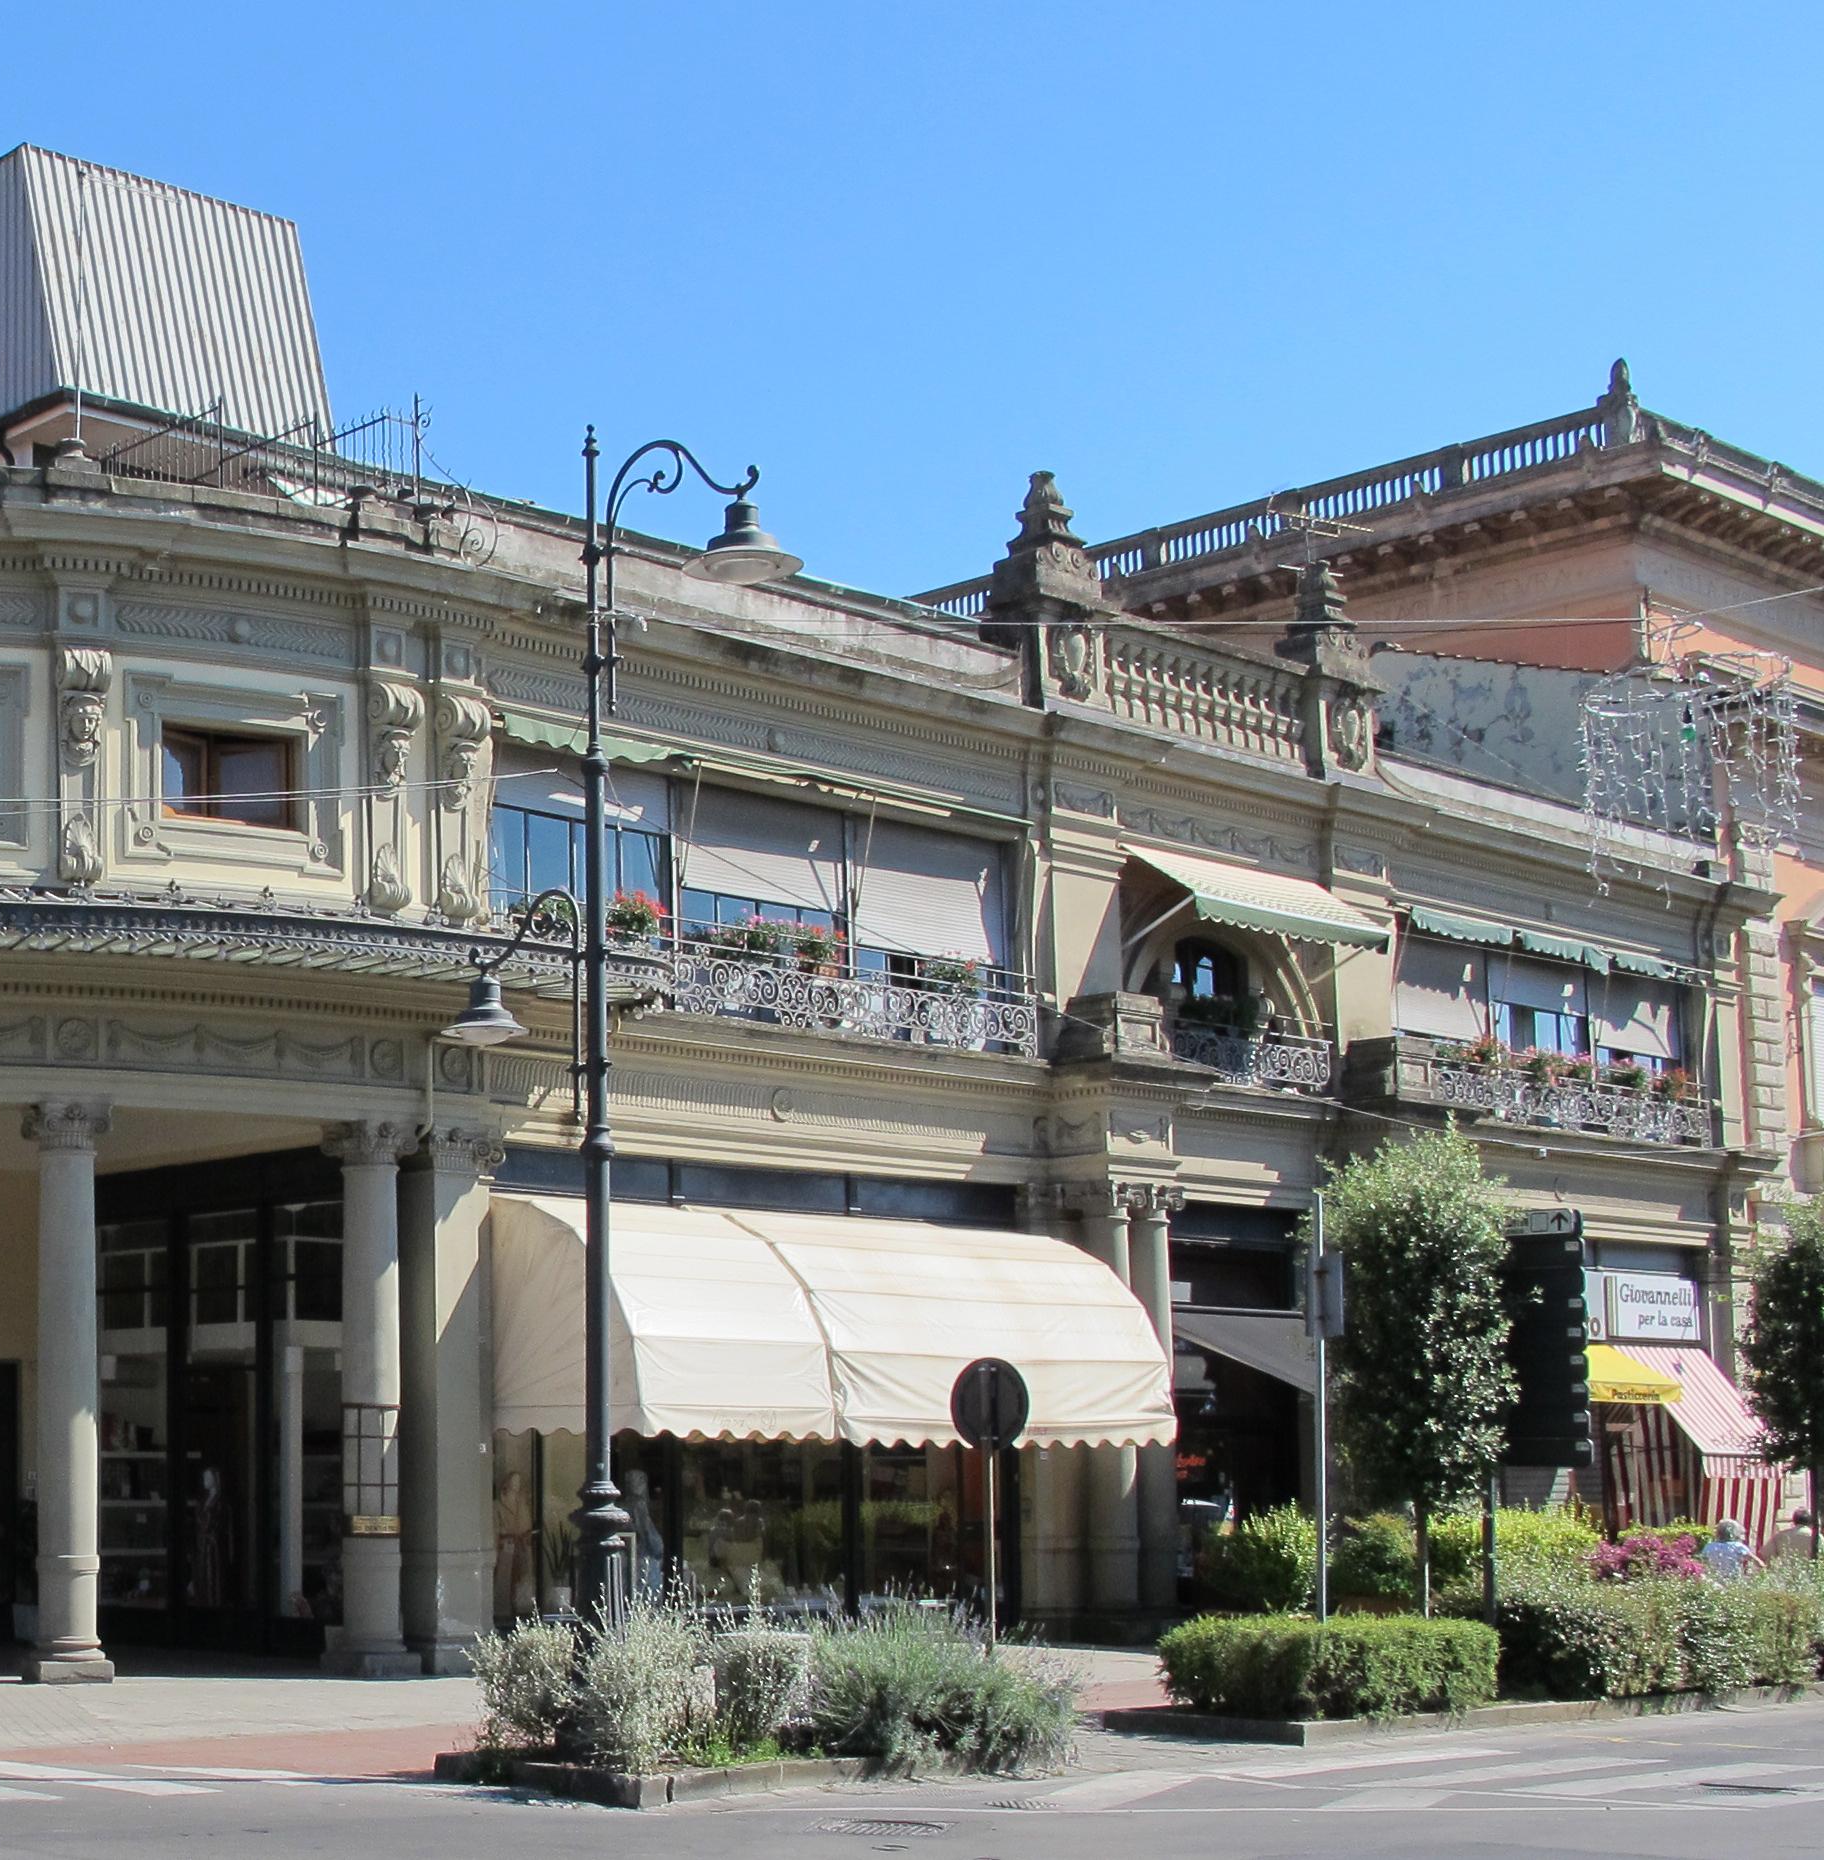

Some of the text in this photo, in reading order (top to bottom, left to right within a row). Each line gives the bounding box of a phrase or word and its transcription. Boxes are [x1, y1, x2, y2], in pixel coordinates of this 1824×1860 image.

[1619, 1283, 1692, 1306] Giovannelli
[1638, 1310, 1693, 1329] per la casa
